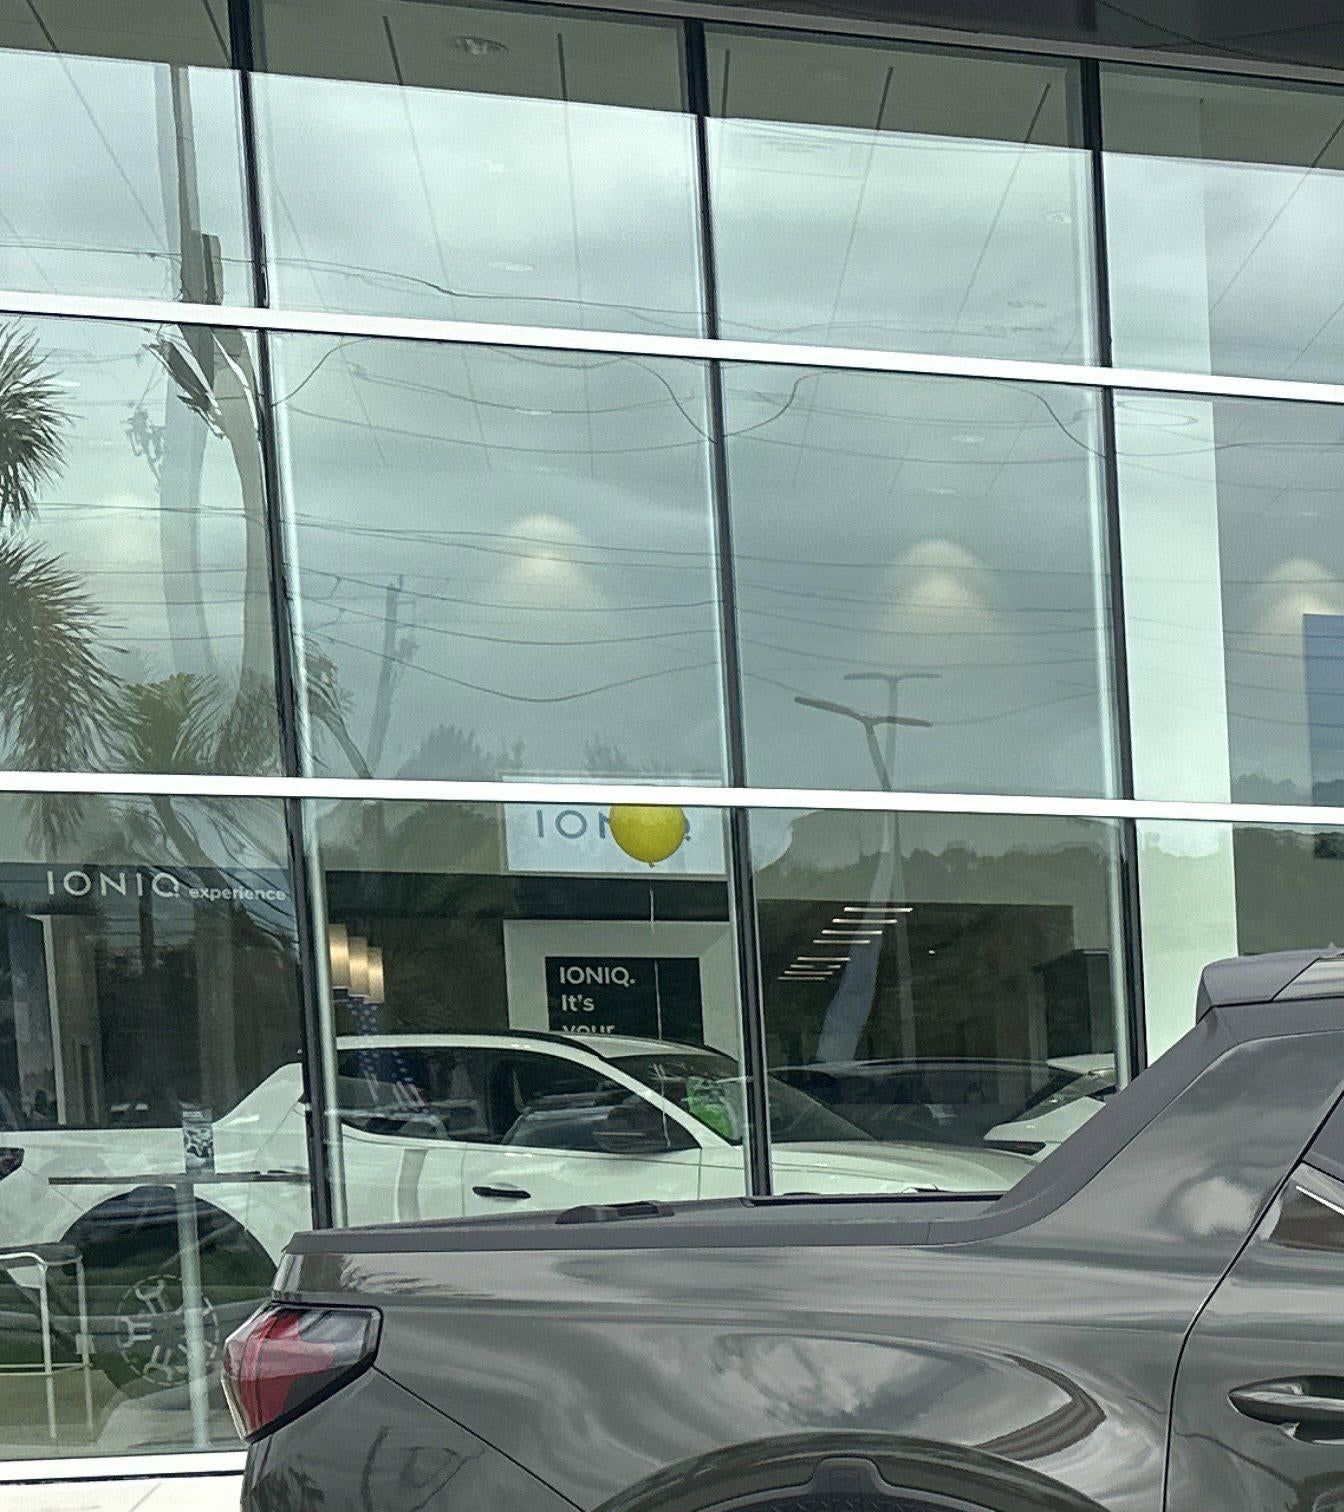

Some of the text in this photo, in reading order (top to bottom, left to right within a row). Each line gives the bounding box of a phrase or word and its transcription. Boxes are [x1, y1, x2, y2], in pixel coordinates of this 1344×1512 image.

[47, 870, 287, 901] IONIQ experience
[559, 965, 636, 988] IONIQ.
[561, 994, 596, 1012] It's
